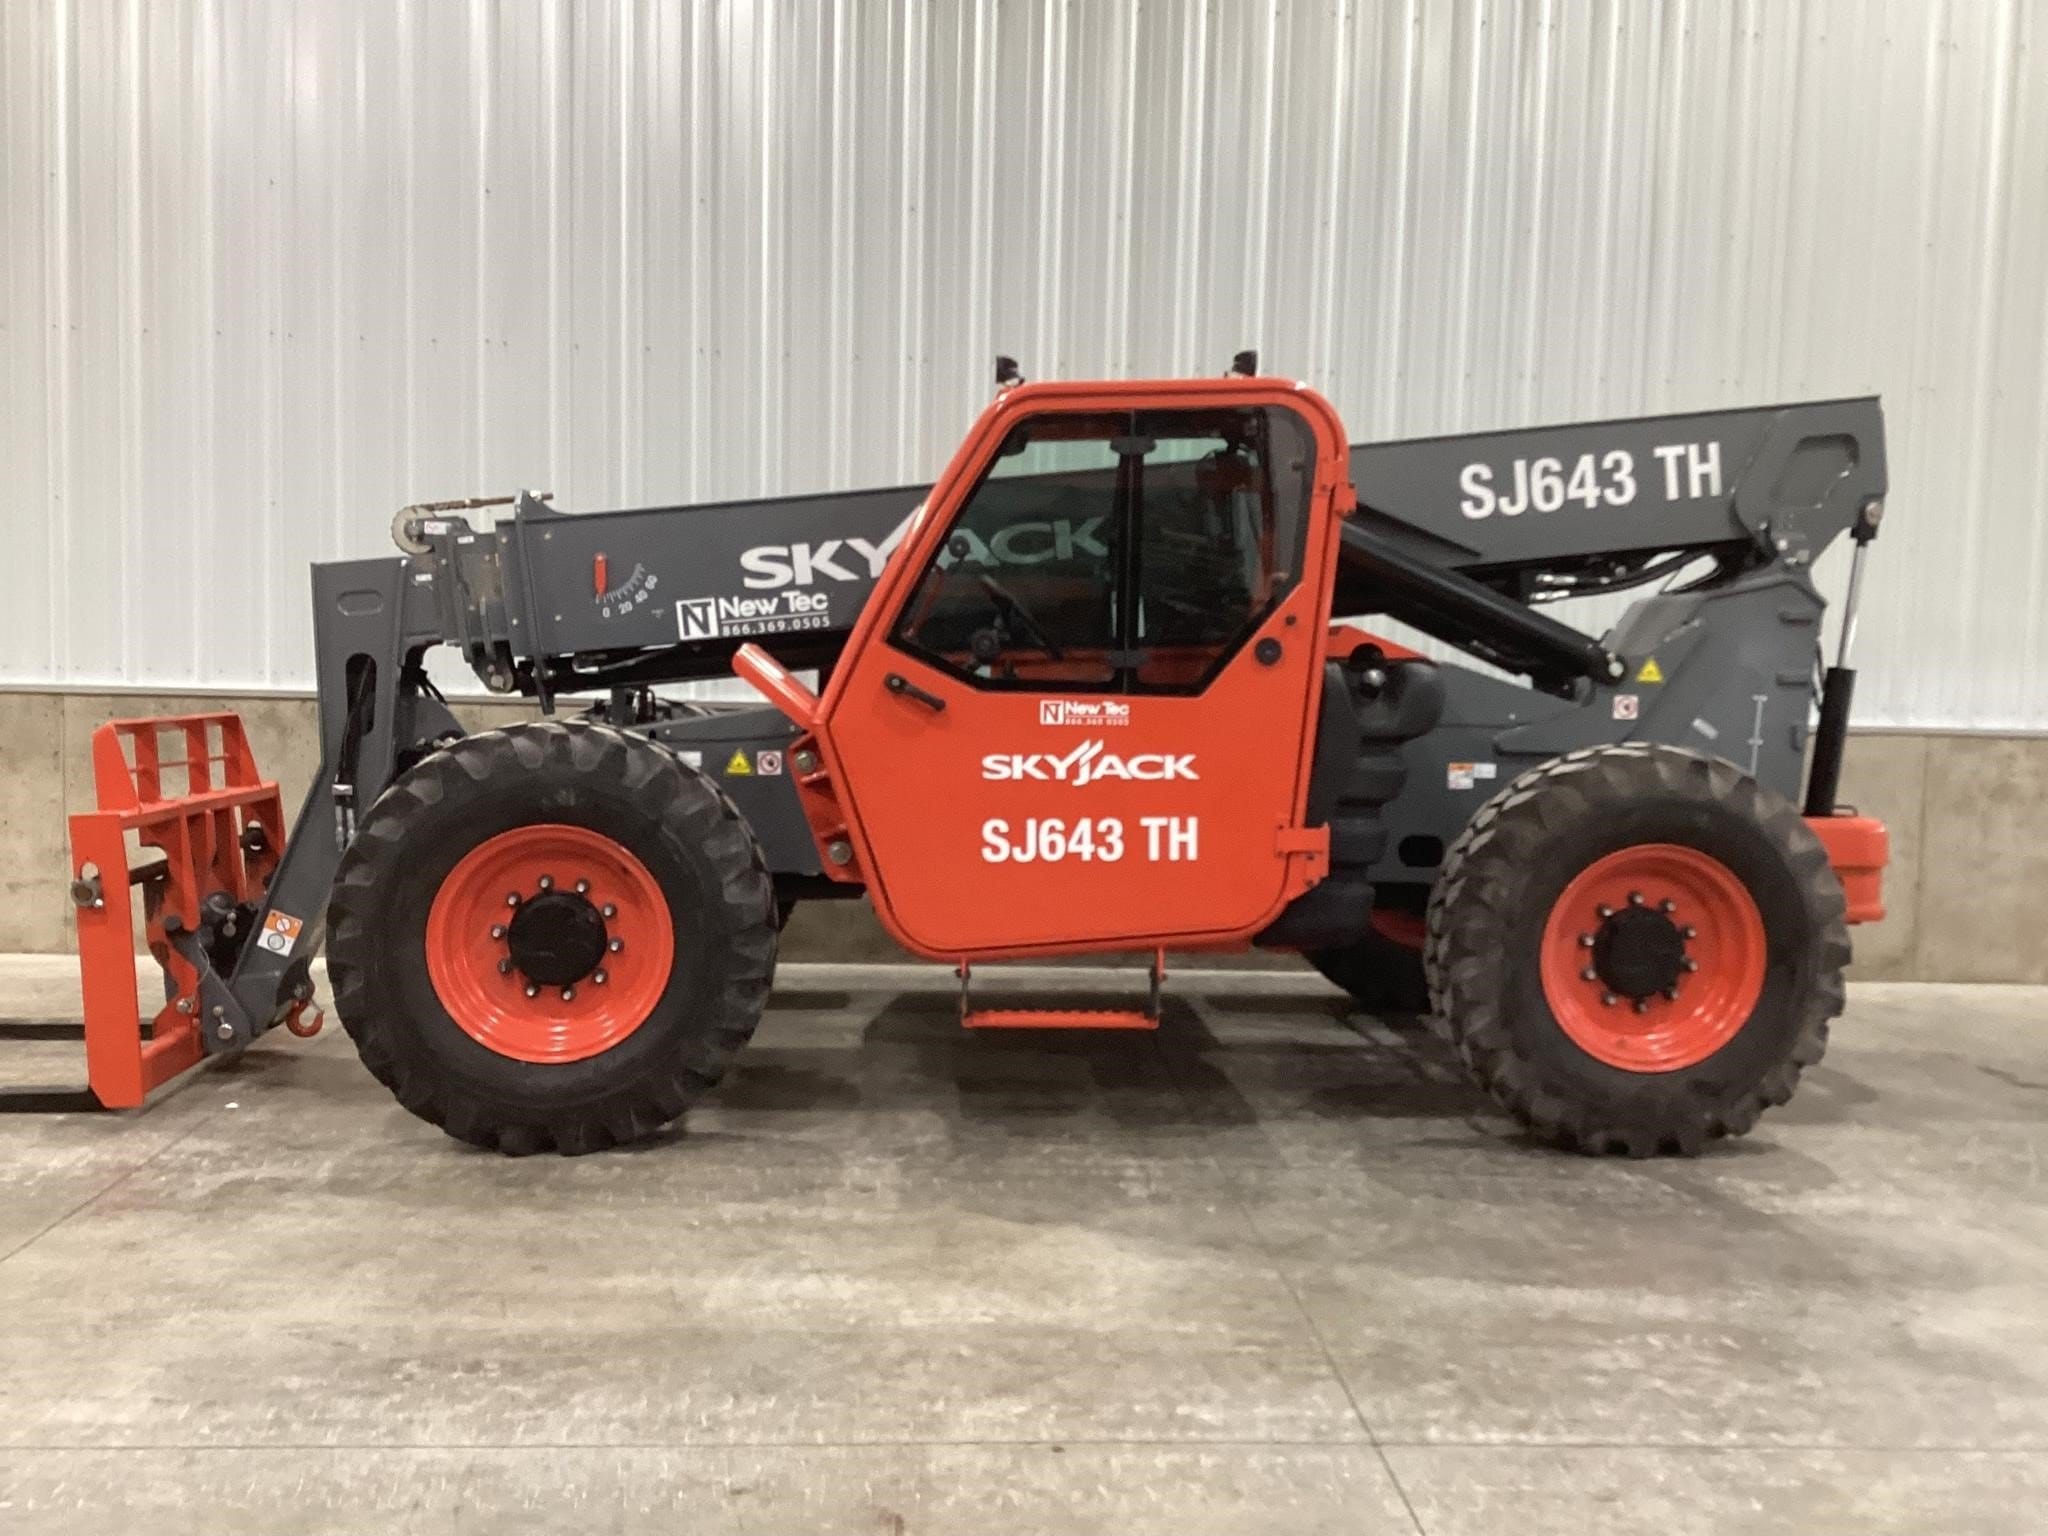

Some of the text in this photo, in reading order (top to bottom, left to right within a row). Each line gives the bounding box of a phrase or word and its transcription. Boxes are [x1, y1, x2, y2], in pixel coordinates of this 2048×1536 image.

[1459, 441, 1723, 520] SJ643 TH
[718, 596, 779, 619] New
[781, 590, 828, 613] Tec
[721, 615, 830, 637] 866.369.0505
[1065, 701, 1101, 715] New
[981, 738, 1200, 787] SKYJACK
[981, 817, 1199, 863] SJ643 TH
